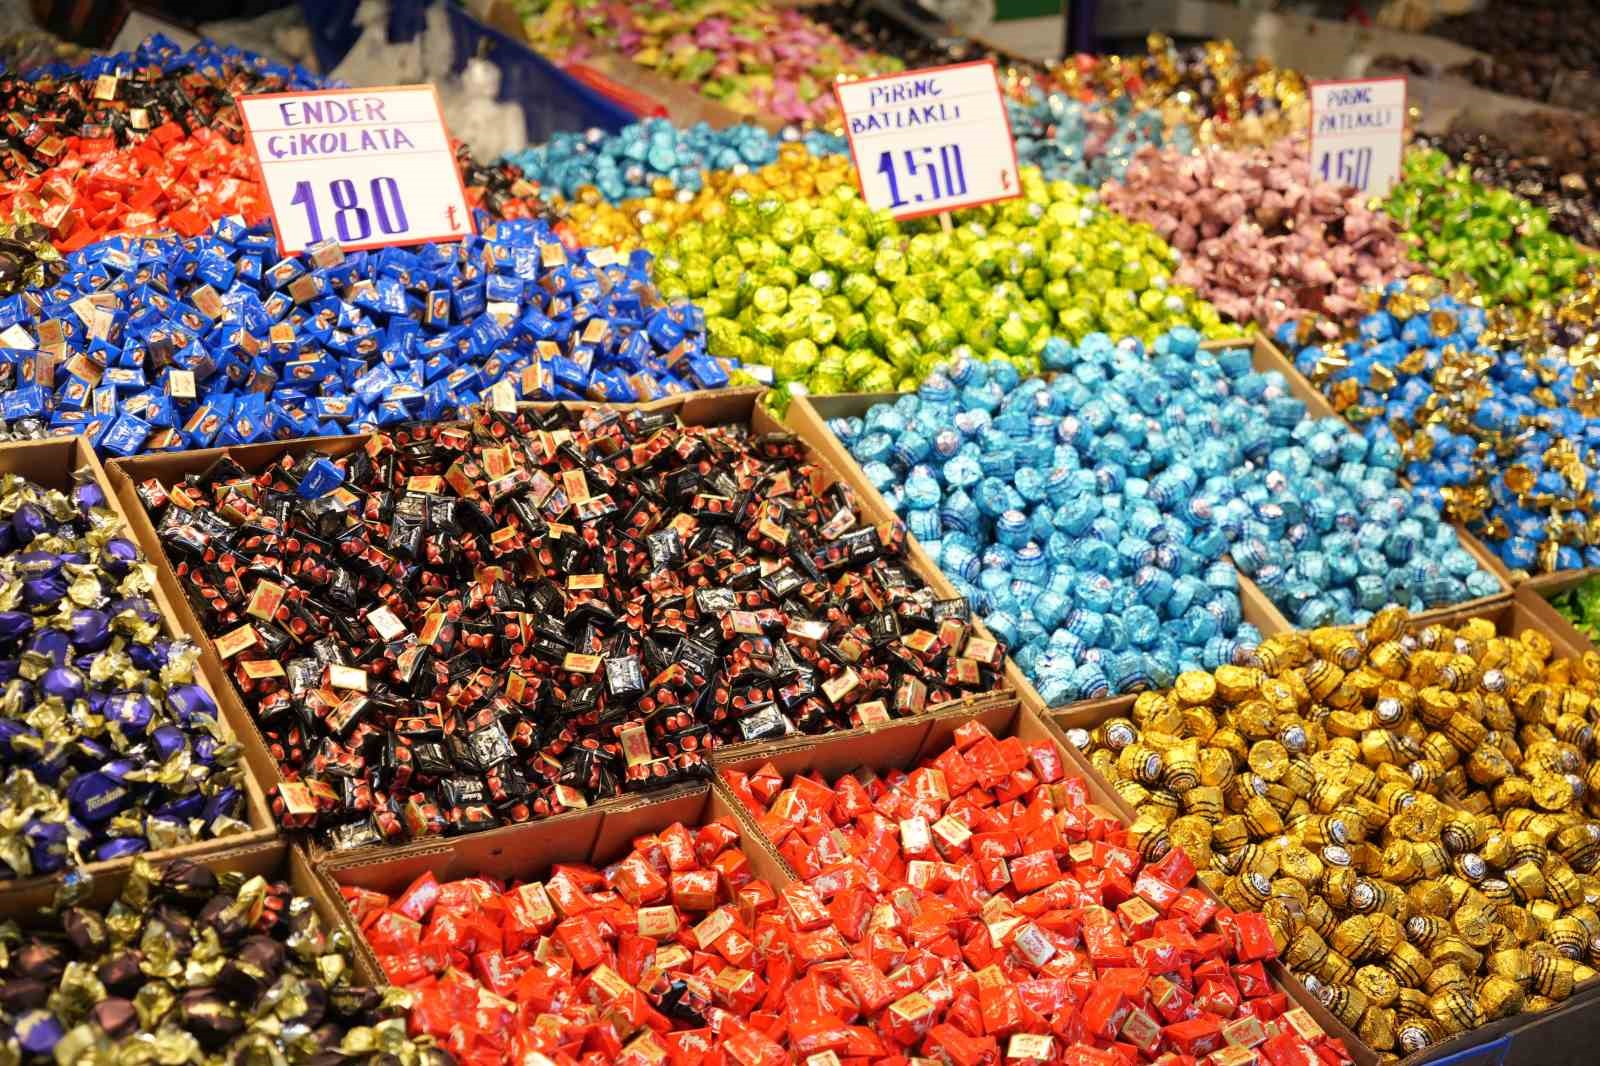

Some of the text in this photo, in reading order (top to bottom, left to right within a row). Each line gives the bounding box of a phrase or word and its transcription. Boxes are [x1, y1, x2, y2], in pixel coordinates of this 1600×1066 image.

[280, 98, 387, 126] ENDER
[877, 144, 967, 208] 150
[290, 177, 408, 247] 180
